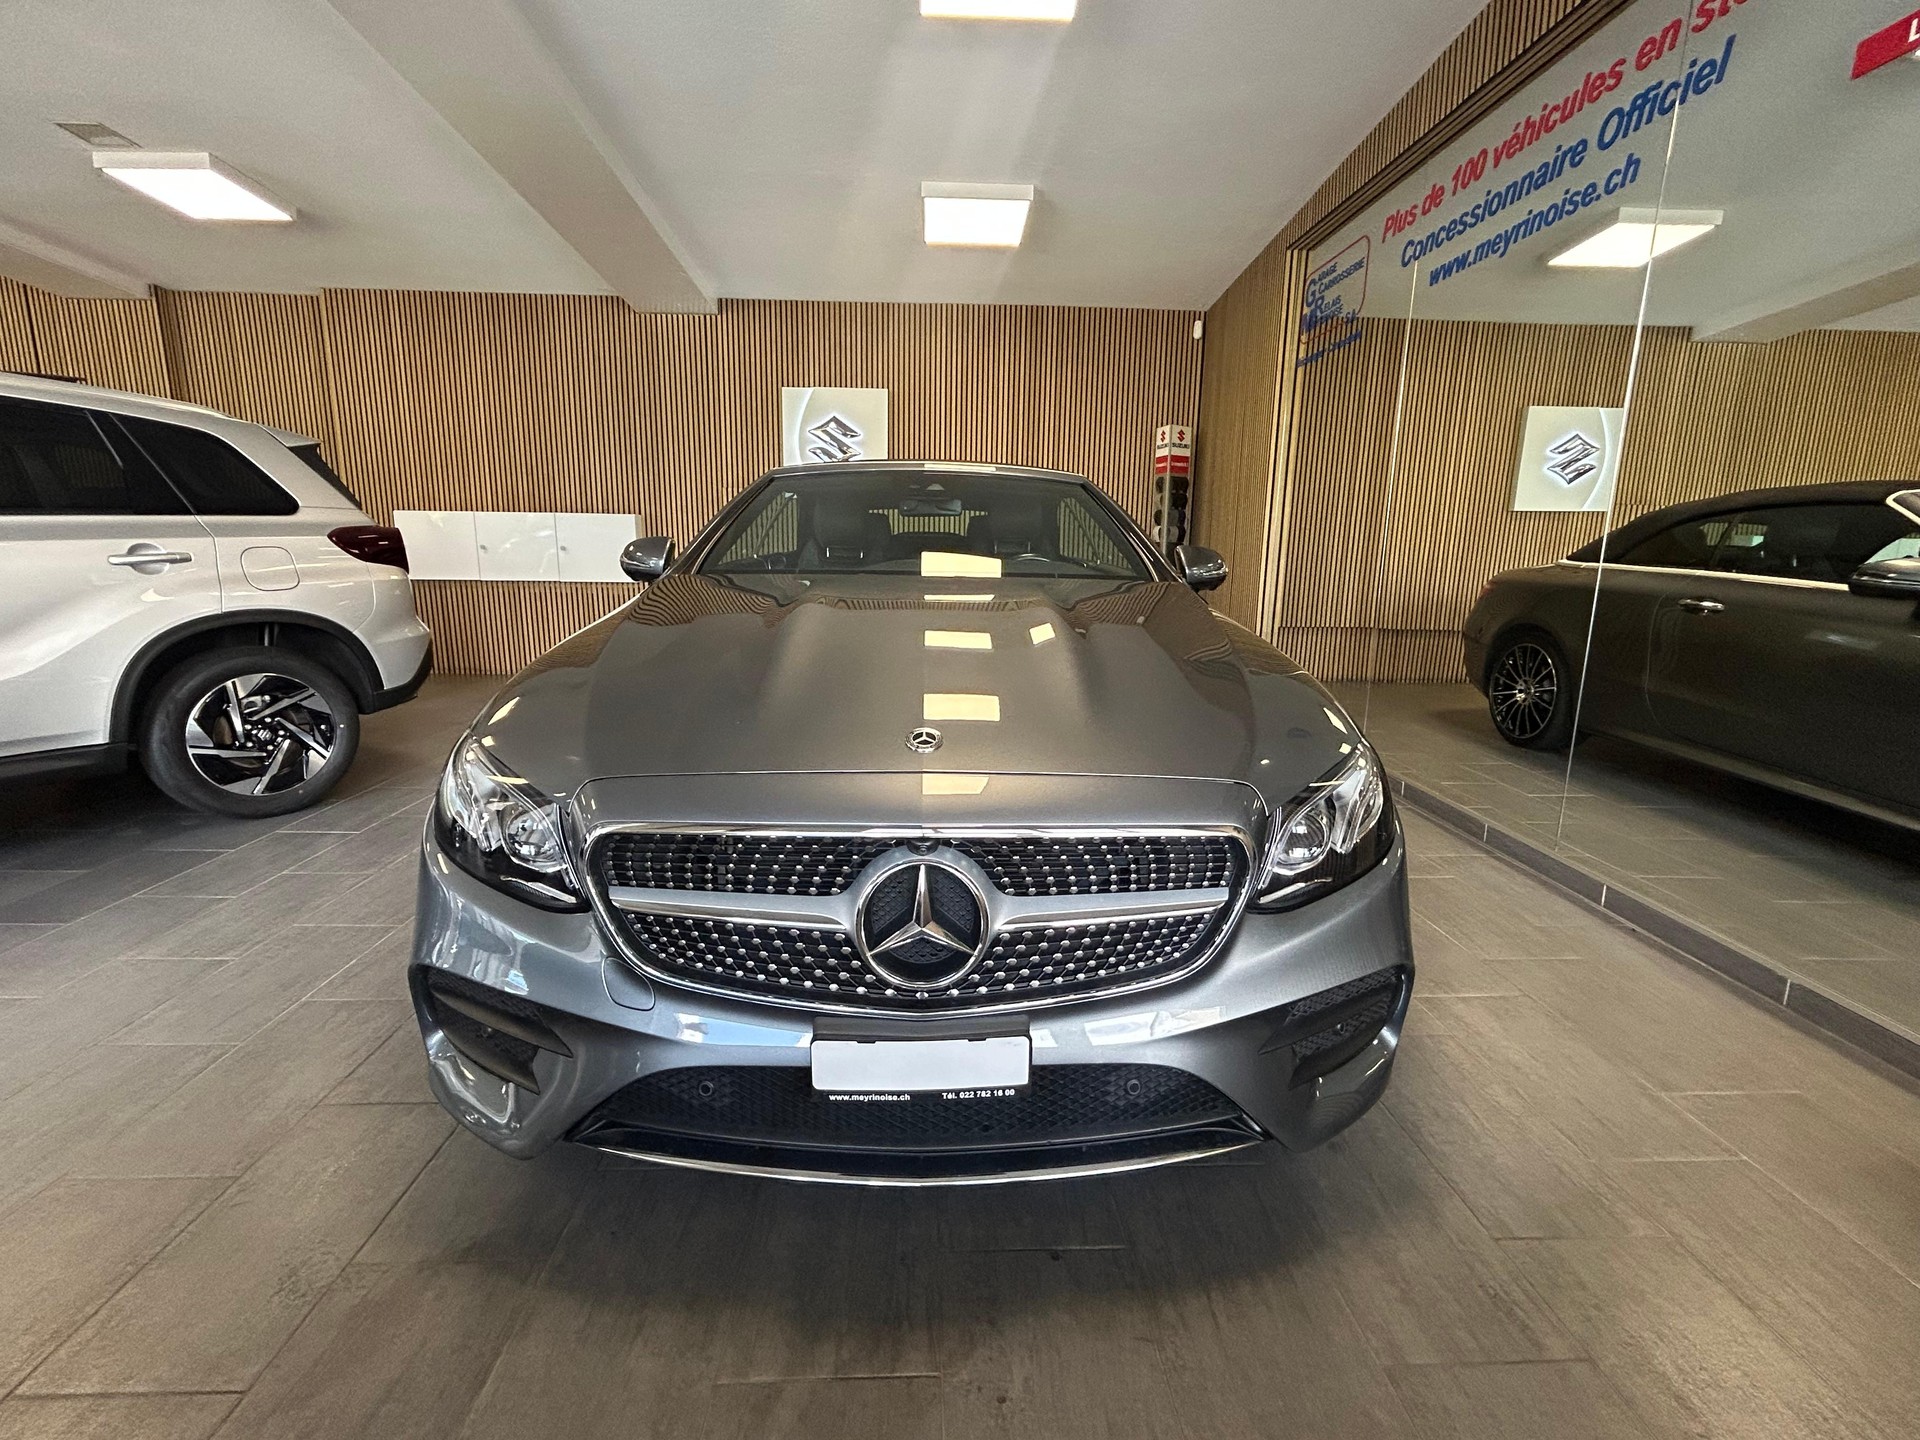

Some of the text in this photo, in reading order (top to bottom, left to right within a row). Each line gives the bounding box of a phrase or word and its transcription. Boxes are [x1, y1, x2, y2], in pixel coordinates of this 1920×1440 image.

[1382, 17, 1683, 243] Plus de 100 véhicules en
[1401, 33, 1737, 268] Concessionnaire Officiel
[1429, 153, 1641, 287] www.meyrinoise.ch
[828, 1093, 911, 1102] www.meyrinoise.ch
[959, 1091, 975, 1099] 022
[976, 1090, 991, 1098] 782
[1004, 1088, 1015, 1096] 00
